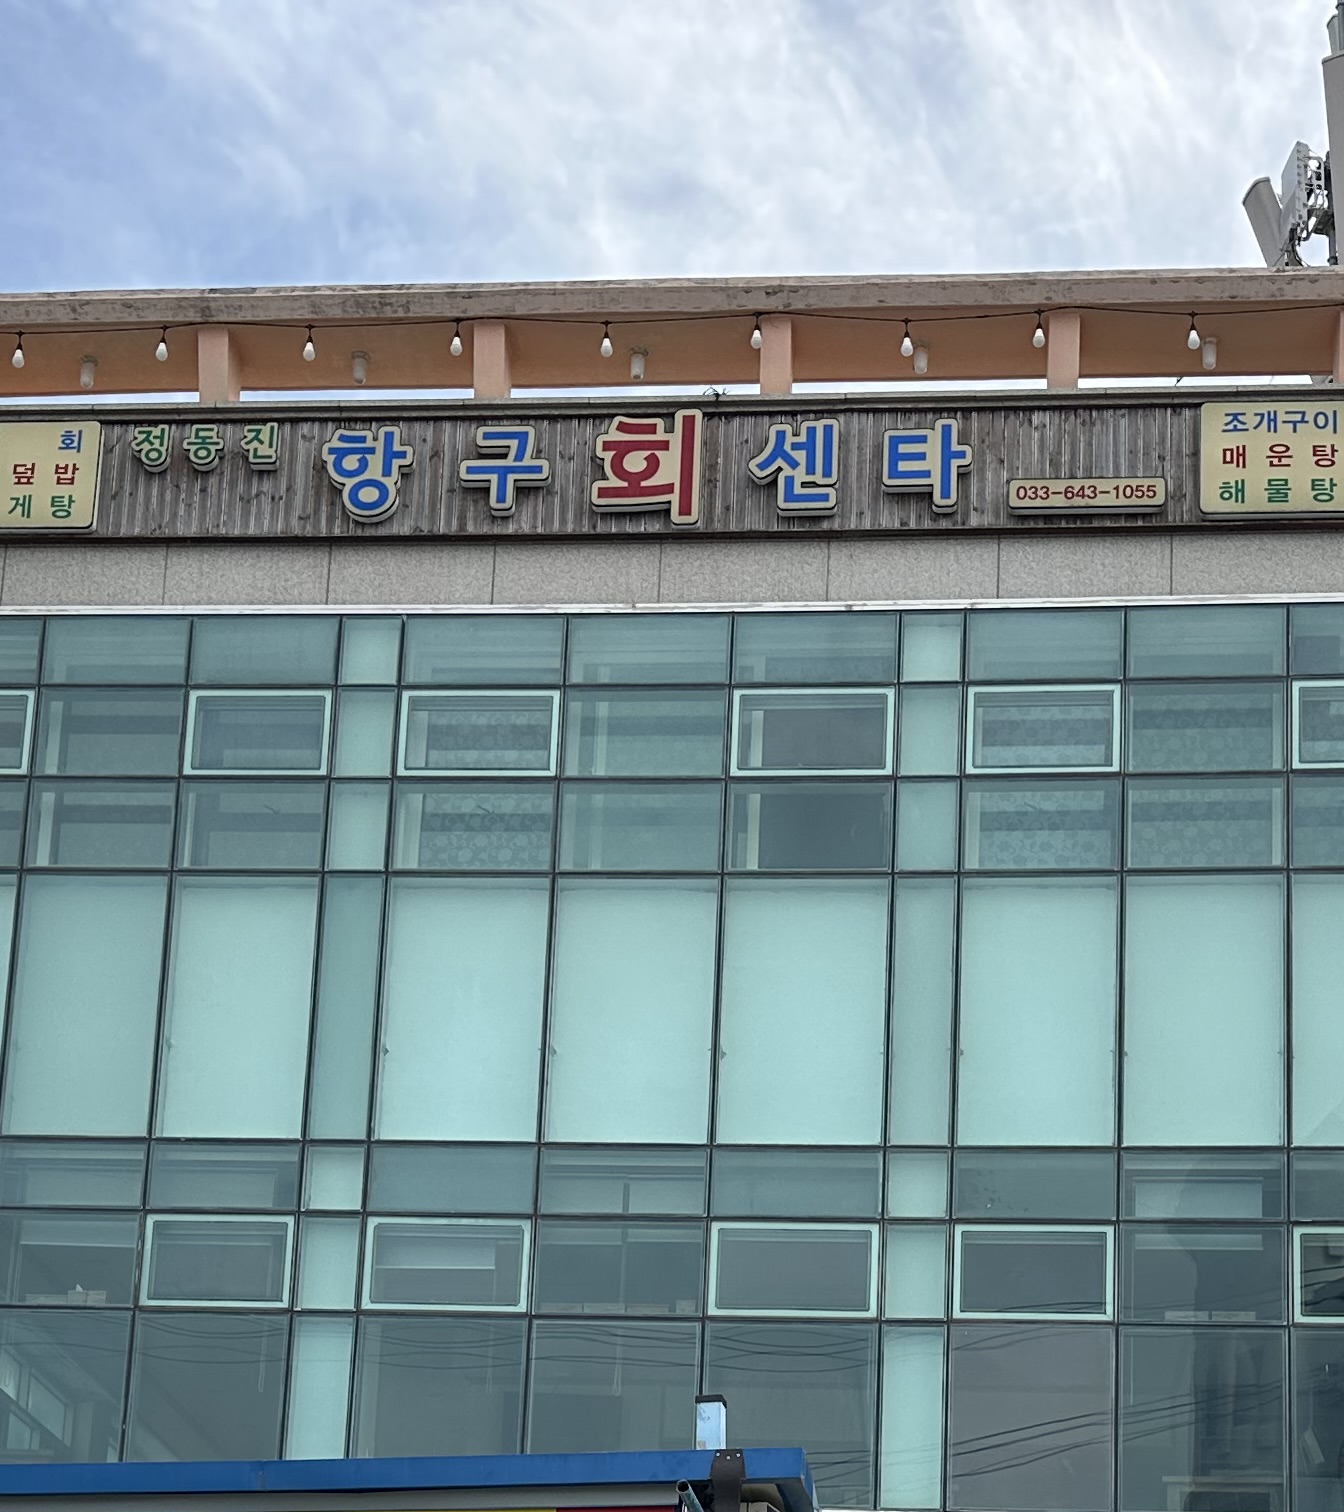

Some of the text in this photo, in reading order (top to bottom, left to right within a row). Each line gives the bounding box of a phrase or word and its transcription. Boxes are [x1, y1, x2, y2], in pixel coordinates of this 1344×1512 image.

[1221, 409, 1339, 435] 조개구이
[133, 412, 968, 518] 정동진 항구회센타
[1221, 442, 1339, 469] 매운탕
[1016, 484, 1156, 501] 033-643-1055
[1218, 477, 1338, 504] 해물탕
